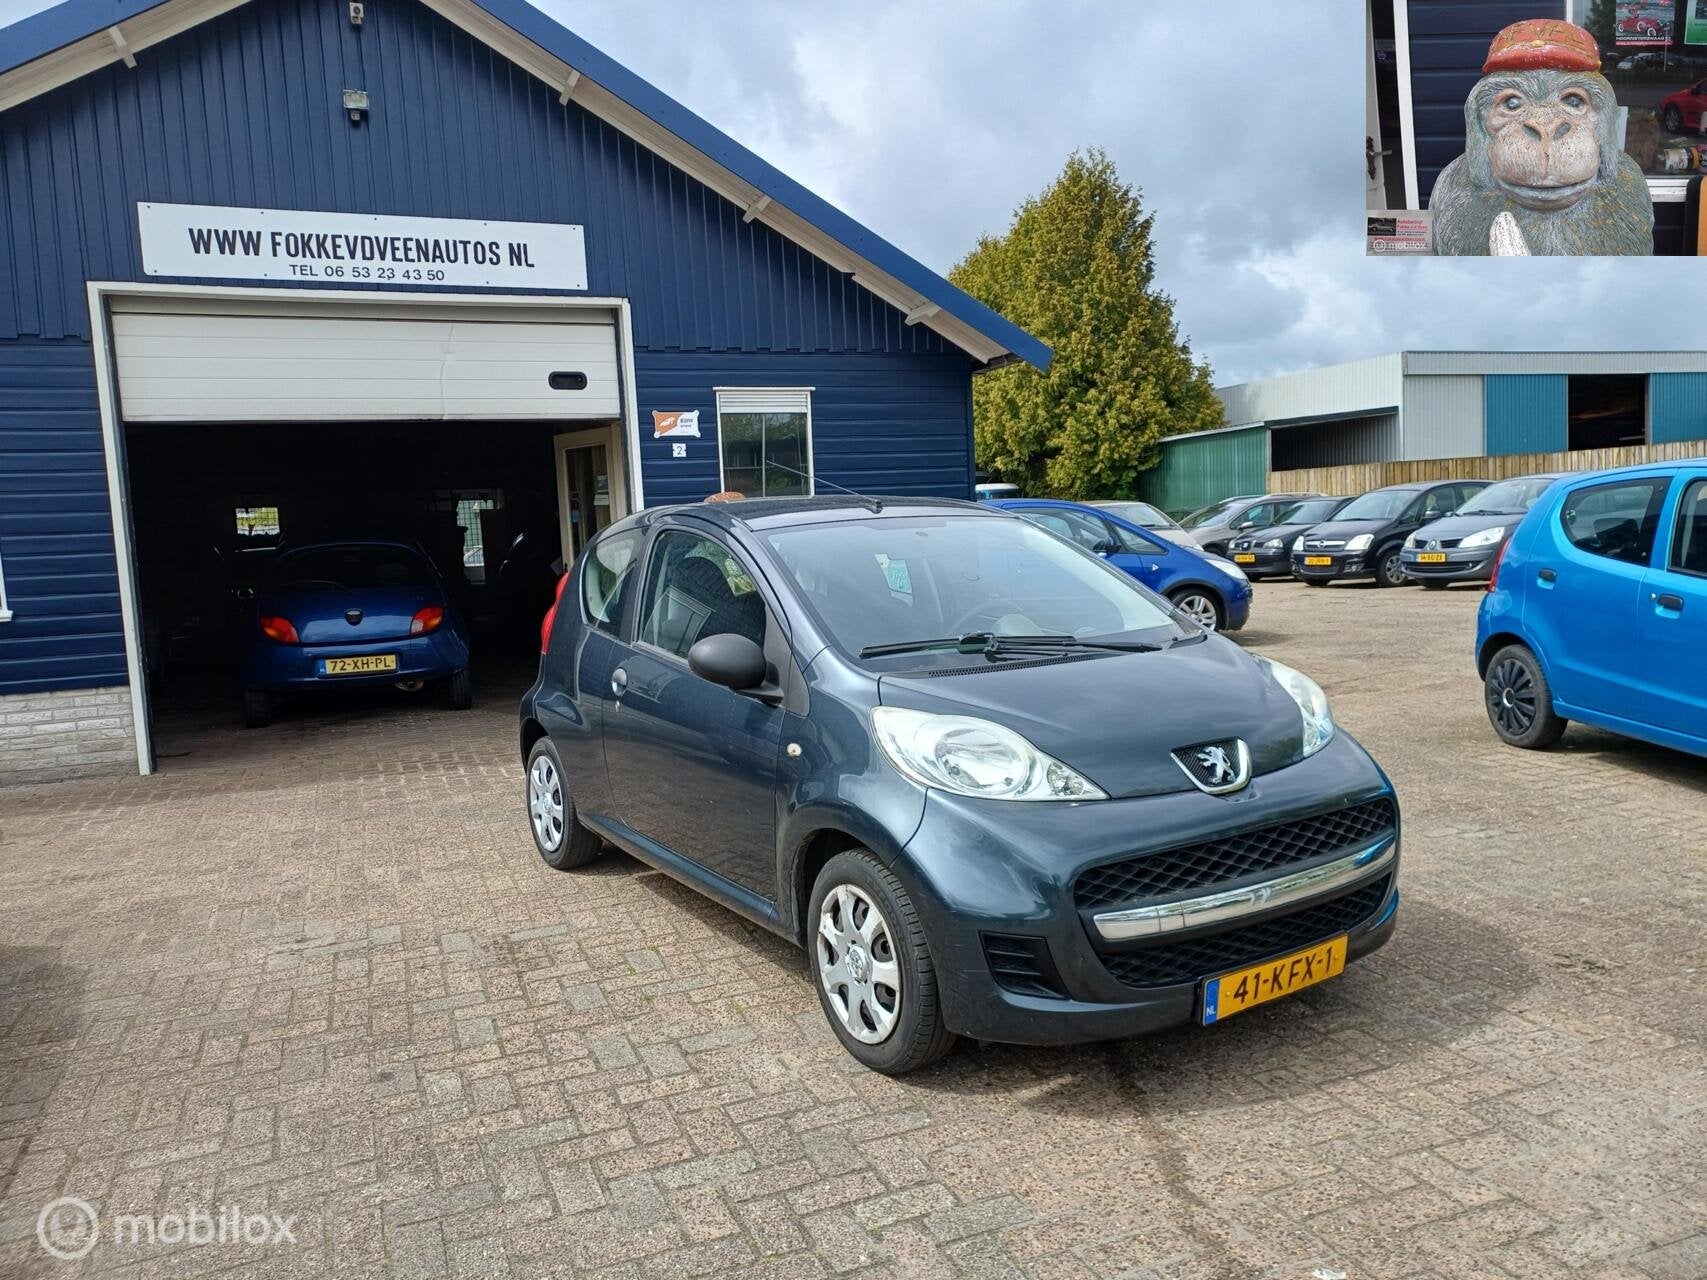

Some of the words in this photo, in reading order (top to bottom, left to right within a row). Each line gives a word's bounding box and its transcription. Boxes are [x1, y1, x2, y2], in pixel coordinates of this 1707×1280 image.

[188, 228, 261, 256] WWW
[271, 231, 501, 266] FOKKEVDVEENAUTOS
[508, 242, 535, 268] NL
[289, 264, 318, 277] TEL
[324, 265, 345, 277] 06
[352, 266, 371, 278] 53
[377, 267, 396, 280] 23
[402, 269, 422, 281] 43
[427, 269, 445, 281] 50
[676, 445, 683, 456] 2
[329, 657, 392, 672] 72-XH-PL
[1232, 946, 1334, 1004] 41-KFX-1
[1205, 1005, 1217, 1017] NL
